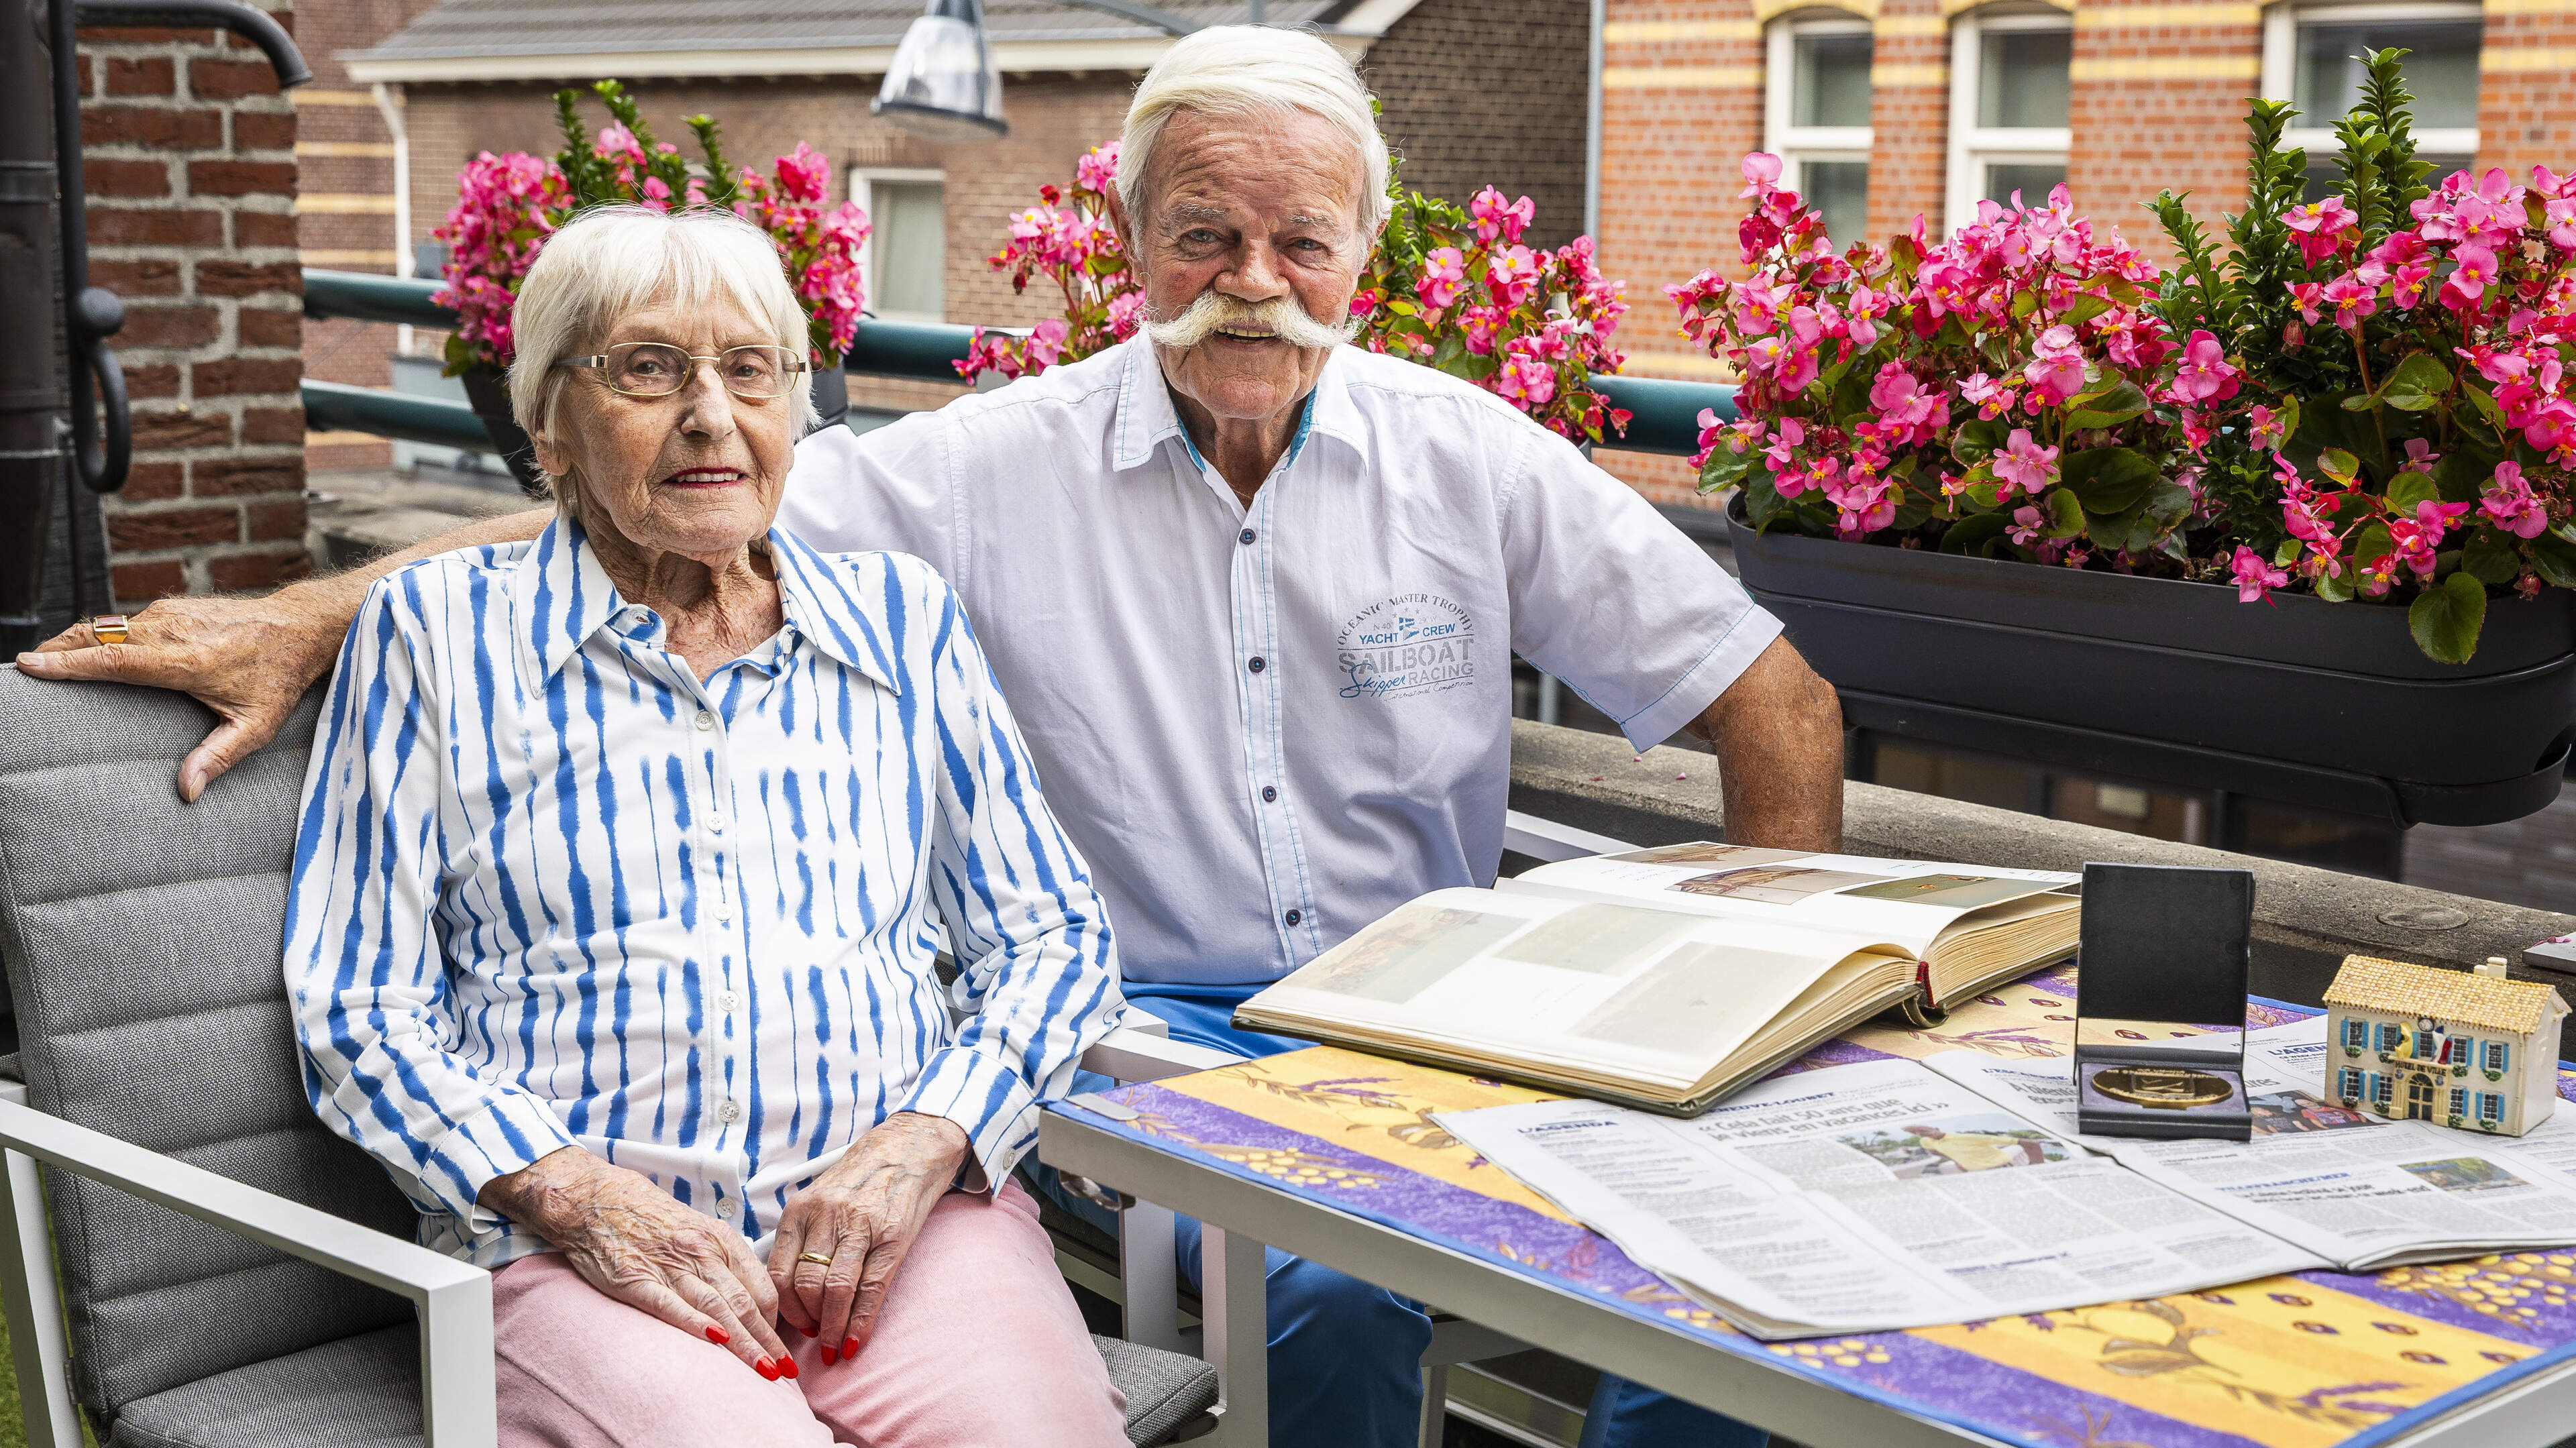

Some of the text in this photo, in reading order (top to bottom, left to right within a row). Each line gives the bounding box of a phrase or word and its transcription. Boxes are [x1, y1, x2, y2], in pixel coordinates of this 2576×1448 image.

[1337, 594, 1475, 646] OCEANIC MASTER TROPHY
[1359, 623, 1456, 645] YACHT CREW
[1338, 638, 1475, 675] SAILBOAT
[1340, 662, 1474, 698] Skipper RACING
[1433, 681, 1474, 694] Competition
[2267, 1045, 2327, 1056] L'AGEN
[2417, 1064, 2426, 1073] DE
[2427, 1066, 2447, 1076] VILLE
[2245, 1078, 2282, 1089] ures
[1704, 1091, 1834, 1115] ENEUVE-LOUBET
[1715, 1119, 1760, 1131] Cela
[1758, 1113, 1796, 1125] fait
[1794, 1109, 1825, 1120] 50
[1827, 1106, 1863, 1116] ans
[1862, 1098, 1904, 1111] que
[1733, 1125, 1790, 1138] viens
[1790, 1121, 1819, 1133] en
[1818, 1109, 1907, 1128] vacances
[1902, 1102, 1932, 1115] ici
